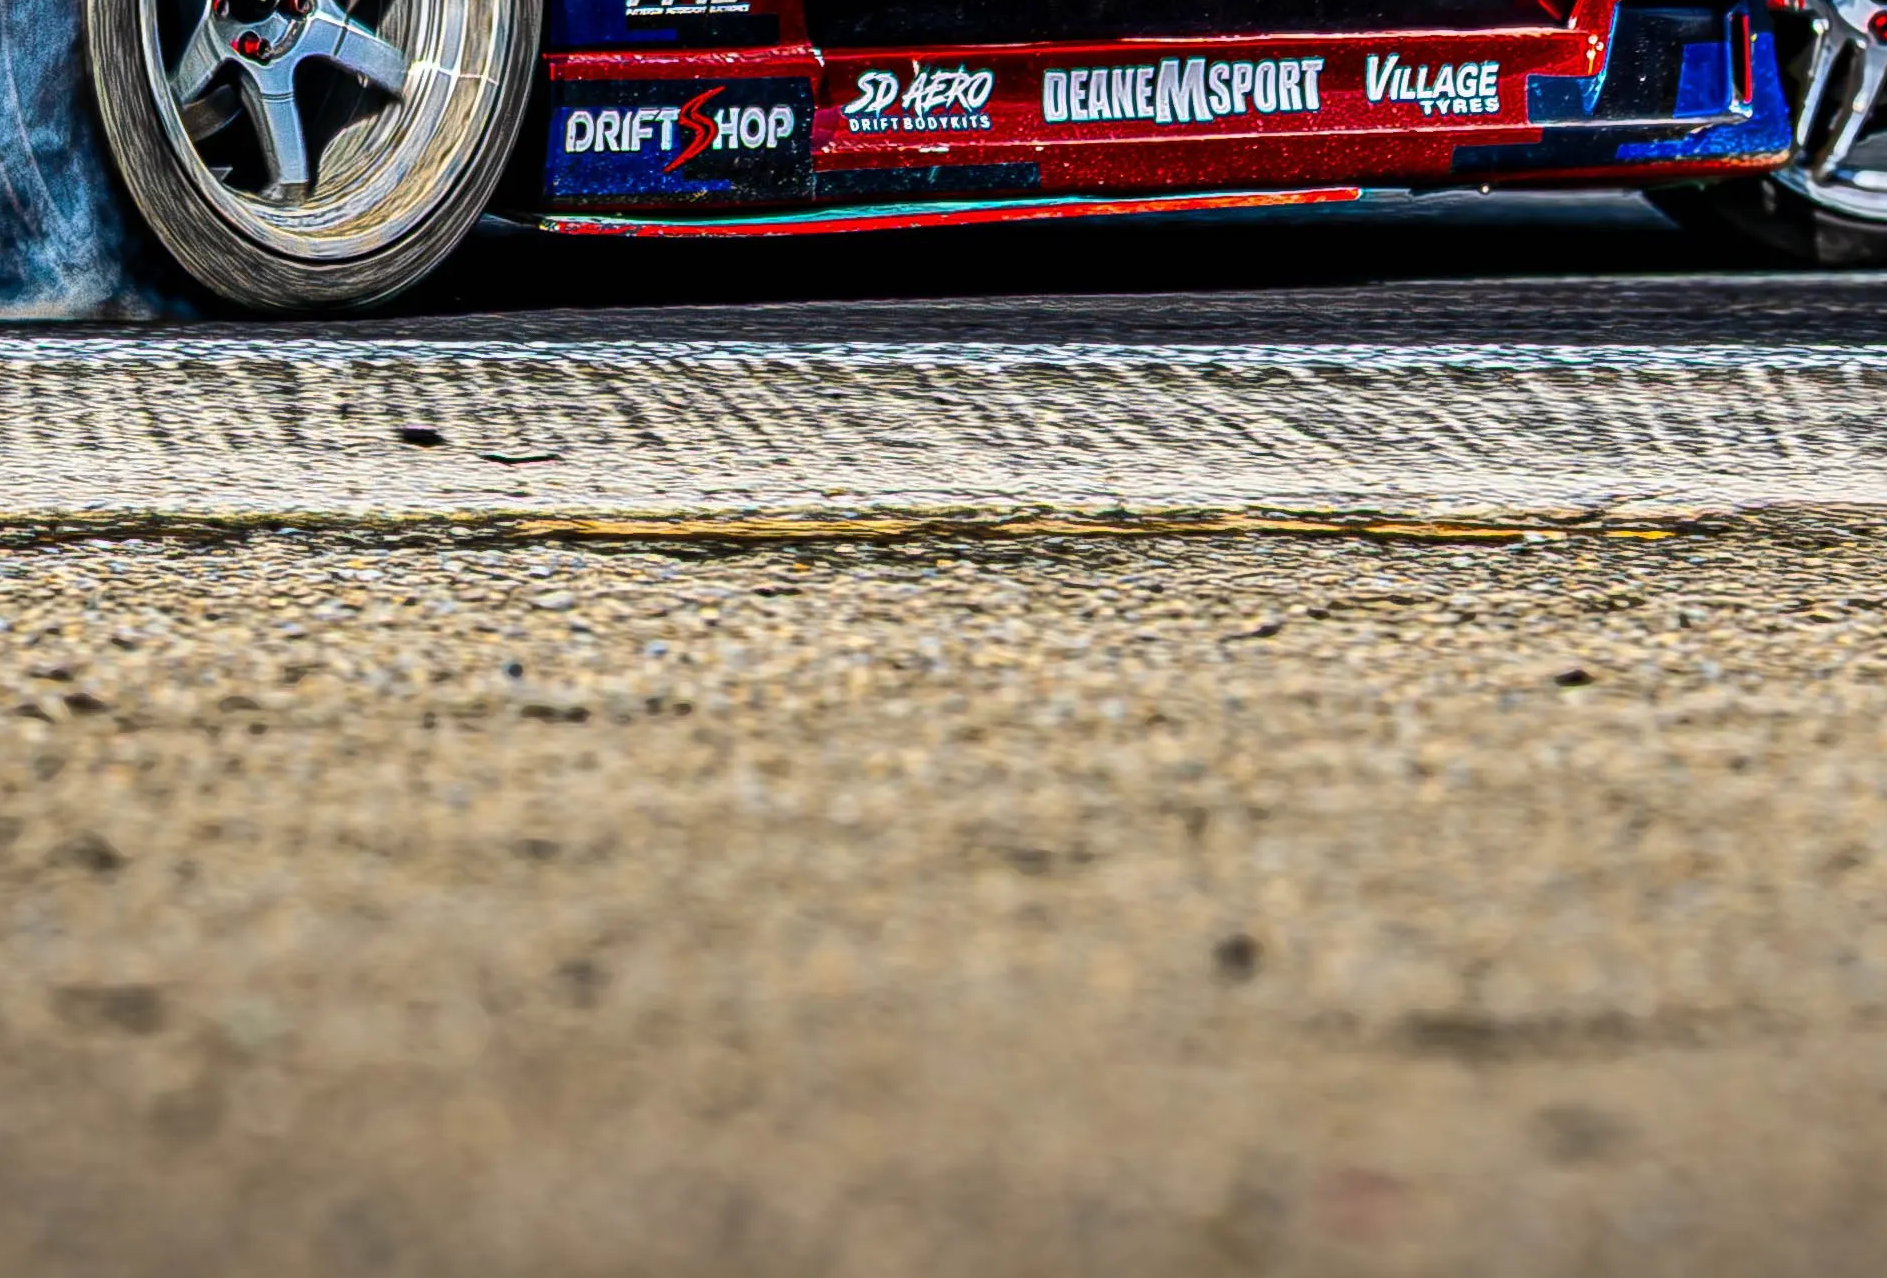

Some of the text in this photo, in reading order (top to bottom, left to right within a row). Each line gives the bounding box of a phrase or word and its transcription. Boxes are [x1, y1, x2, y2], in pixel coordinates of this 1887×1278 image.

[901, 63, 995, 112] AERO
[1365, 52, 1500, 103] VILLAGE
[1419, 96, 1500, 115] TYRES
[849, 114, 991, 133] DRIFT BODYKITS
